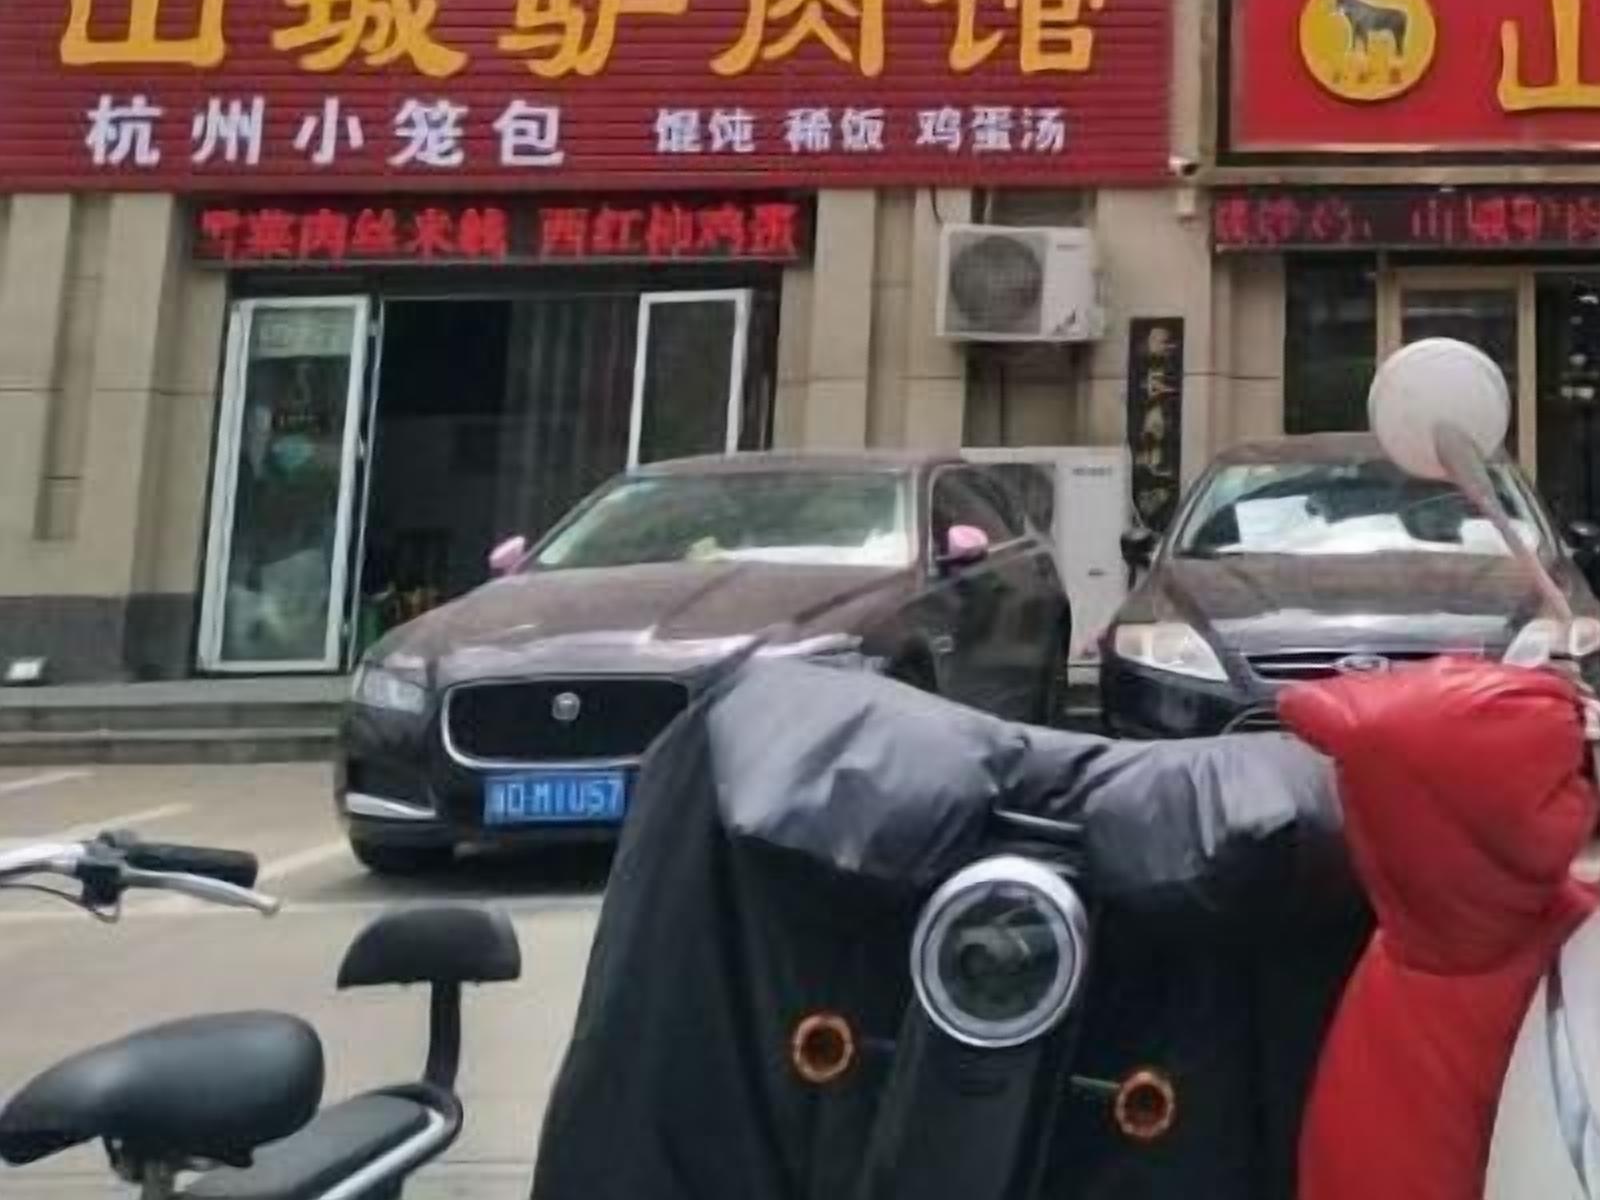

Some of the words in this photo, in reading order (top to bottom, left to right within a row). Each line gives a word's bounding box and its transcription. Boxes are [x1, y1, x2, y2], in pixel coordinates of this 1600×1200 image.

[86, 94, 566, 168] 杭州小笼包
[654, 106, 756, 153] 馄饨
[783, 106, 886, 154] 稀饭
[915, 105, 1067, 154] 鸡蛋汤
